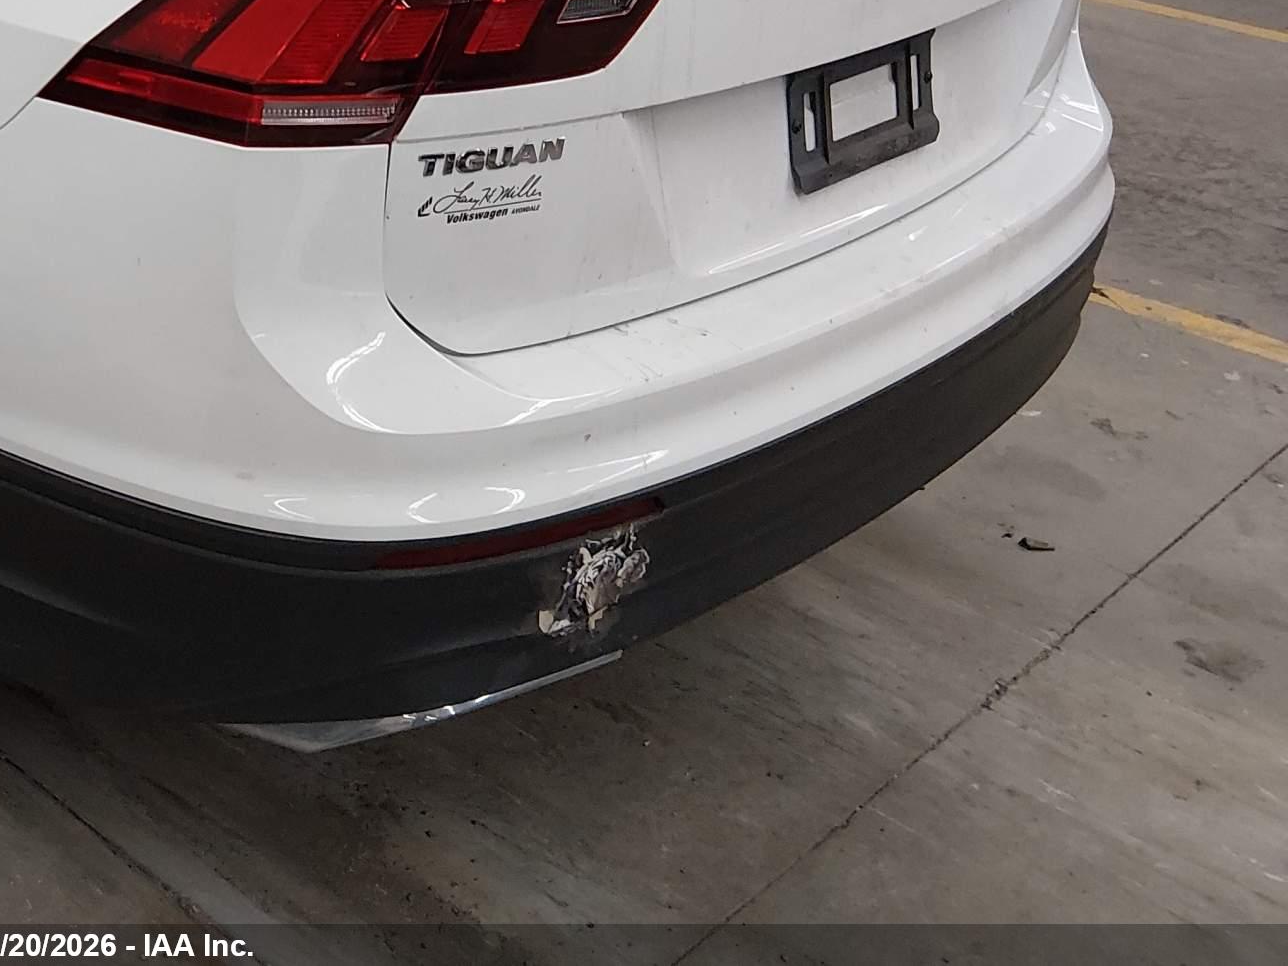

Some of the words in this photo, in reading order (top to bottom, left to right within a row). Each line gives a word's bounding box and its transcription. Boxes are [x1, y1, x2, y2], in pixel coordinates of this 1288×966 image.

[417, 136, 567, 178] TIGUAN
[493, 173, 543, 204] Miller
[446, 207, 509, 224] Volkswagen
